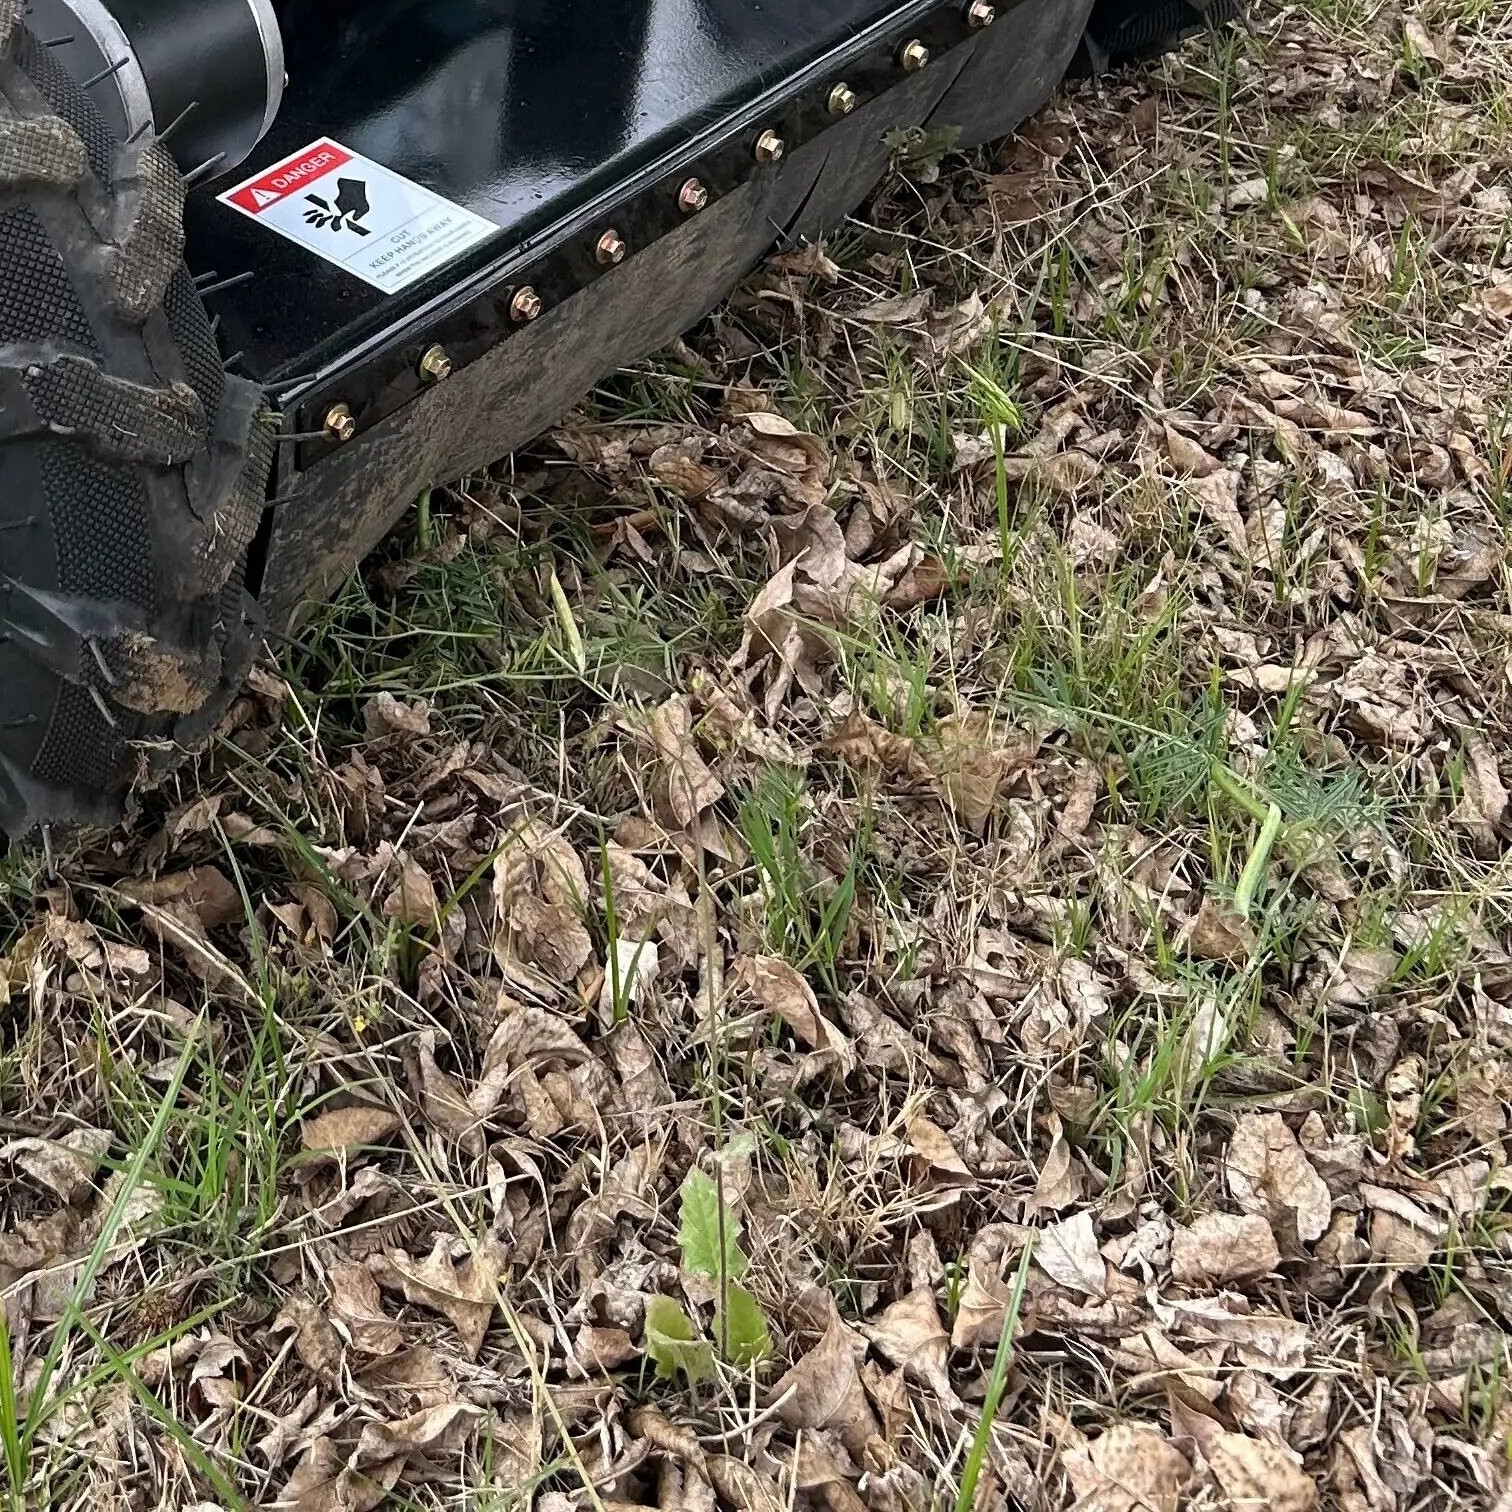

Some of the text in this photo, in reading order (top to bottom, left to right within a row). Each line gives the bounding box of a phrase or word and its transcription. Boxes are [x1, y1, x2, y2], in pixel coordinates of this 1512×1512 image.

[271, 151, 337, 190] DANGER
[369, 250, 396, 269] KEEP
[393, 233, 430, 256] HANDS
[425, 216, 453, 238] AWAY
[390, 229, 411, 244] CUT
